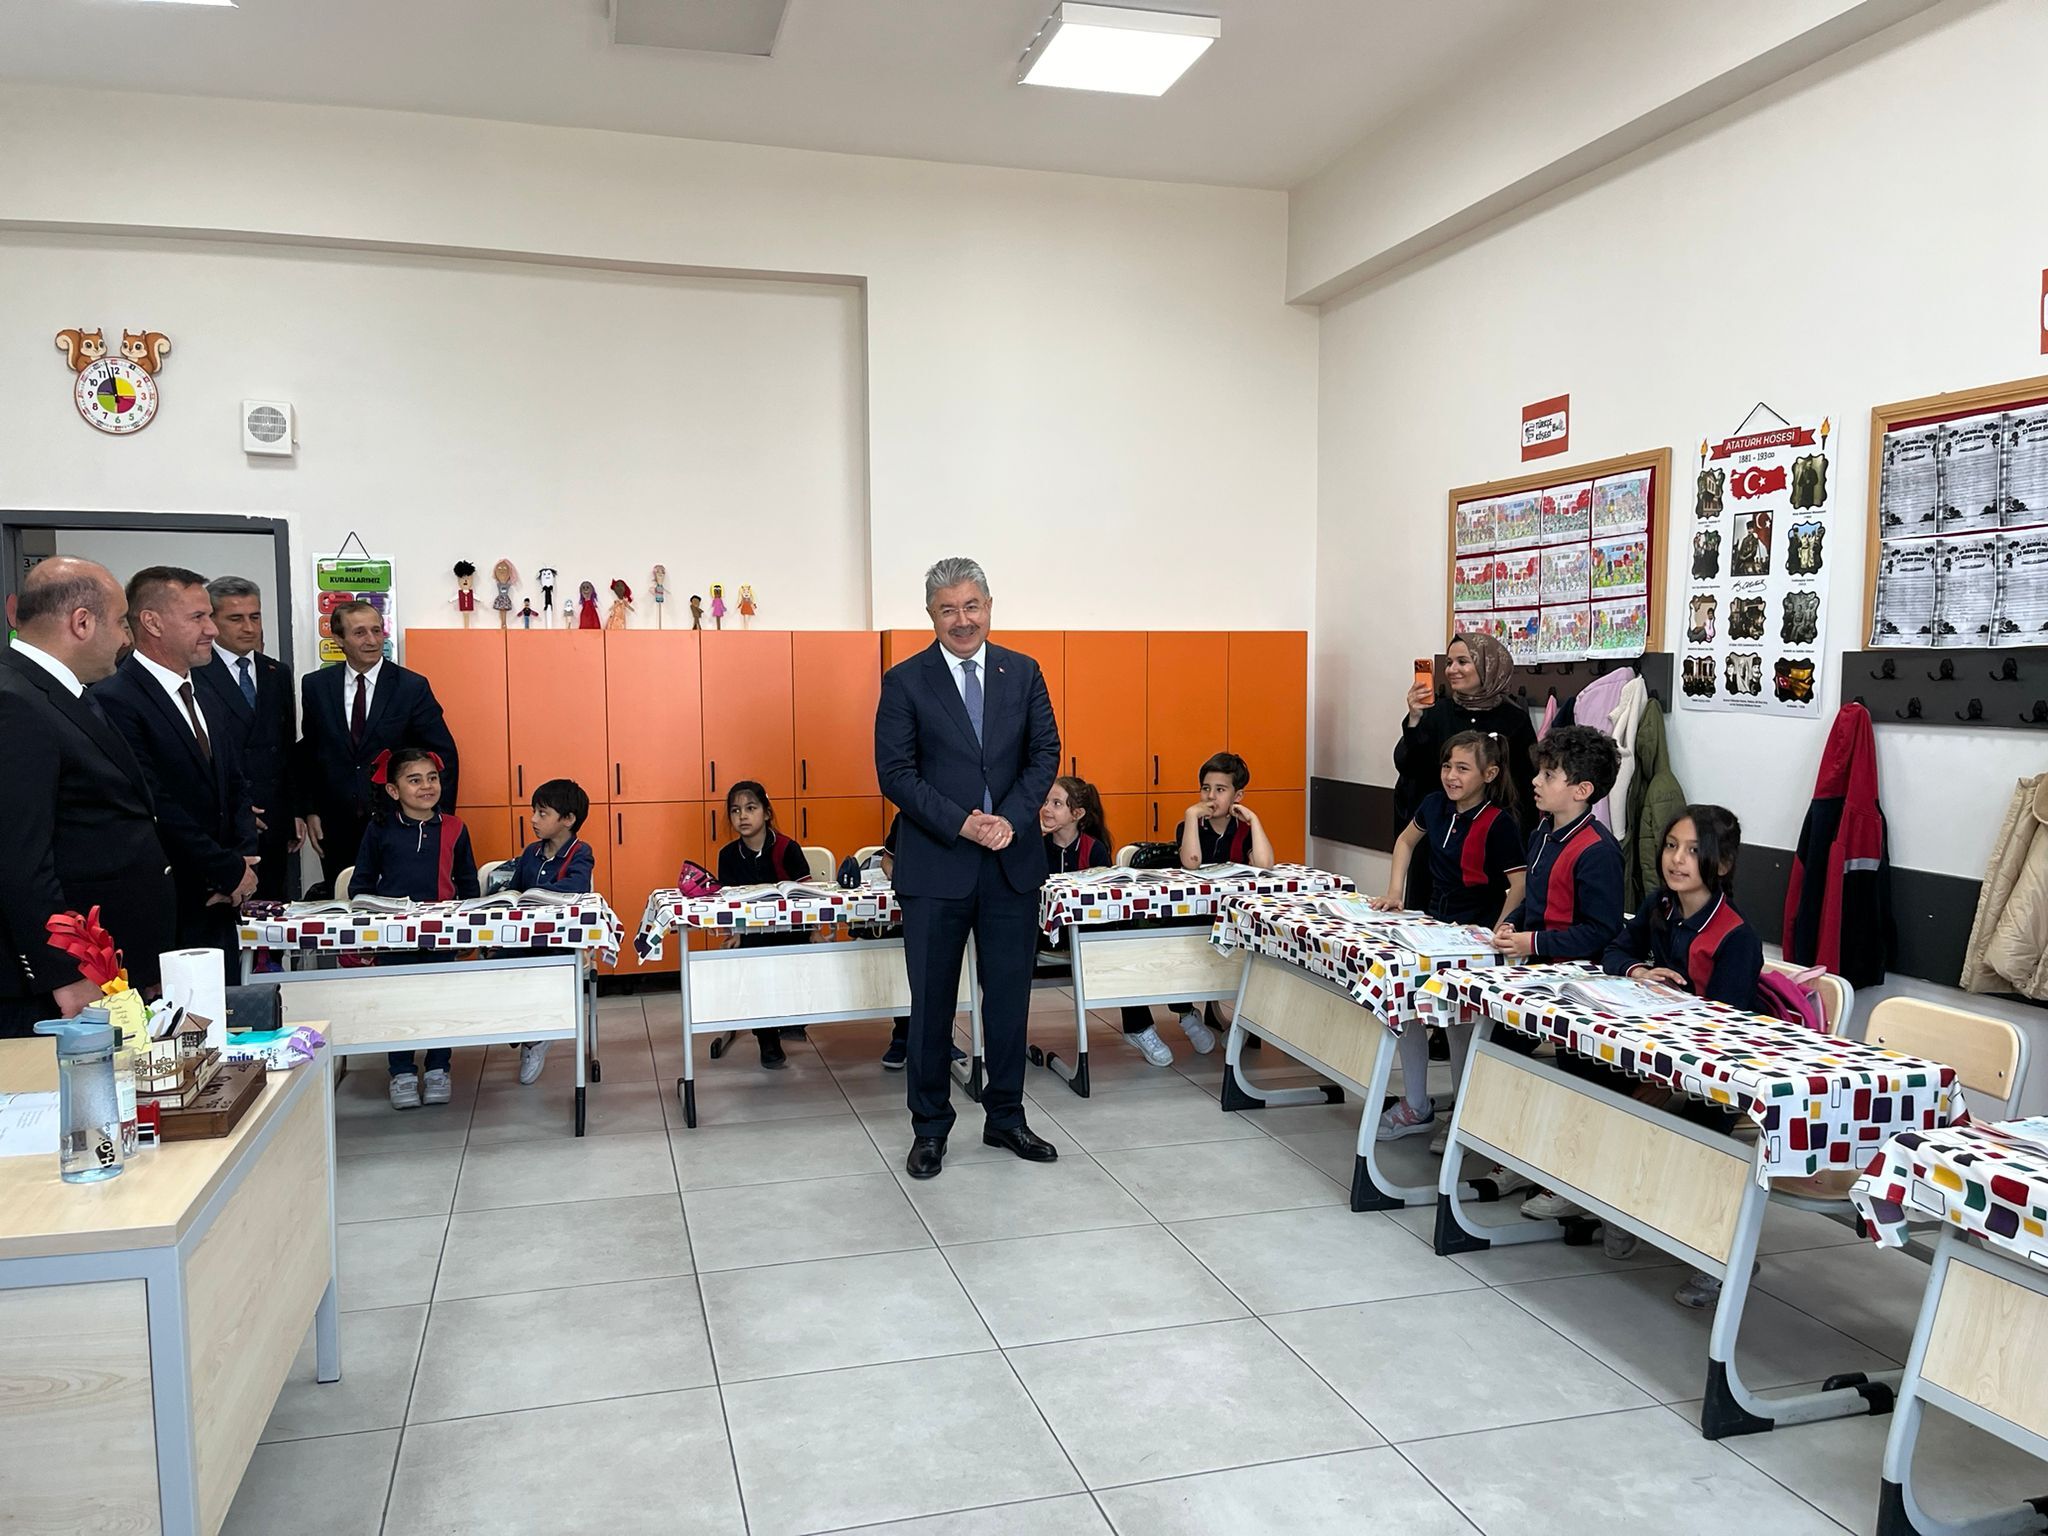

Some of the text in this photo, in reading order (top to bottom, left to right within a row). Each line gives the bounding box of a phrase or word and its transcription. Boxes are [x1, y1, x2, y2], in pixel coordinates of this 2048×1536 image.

[98, 370, 106, 378] 11
[110, 366, 120, 375] 12
[89, 379, 98, 387] 10
[136, 380, 142, 388] 2
[140, 392, 147, 400] 3
[92, 403, 98, 411] 8
[102, 412, 108, 420] 7
[115, 416, 121, 424] 6
[128, 413, 135, 421] 5
[1738, 454, 1752, 463] 1881
[329, 576, 381, 584] KURALLARIMIZ
